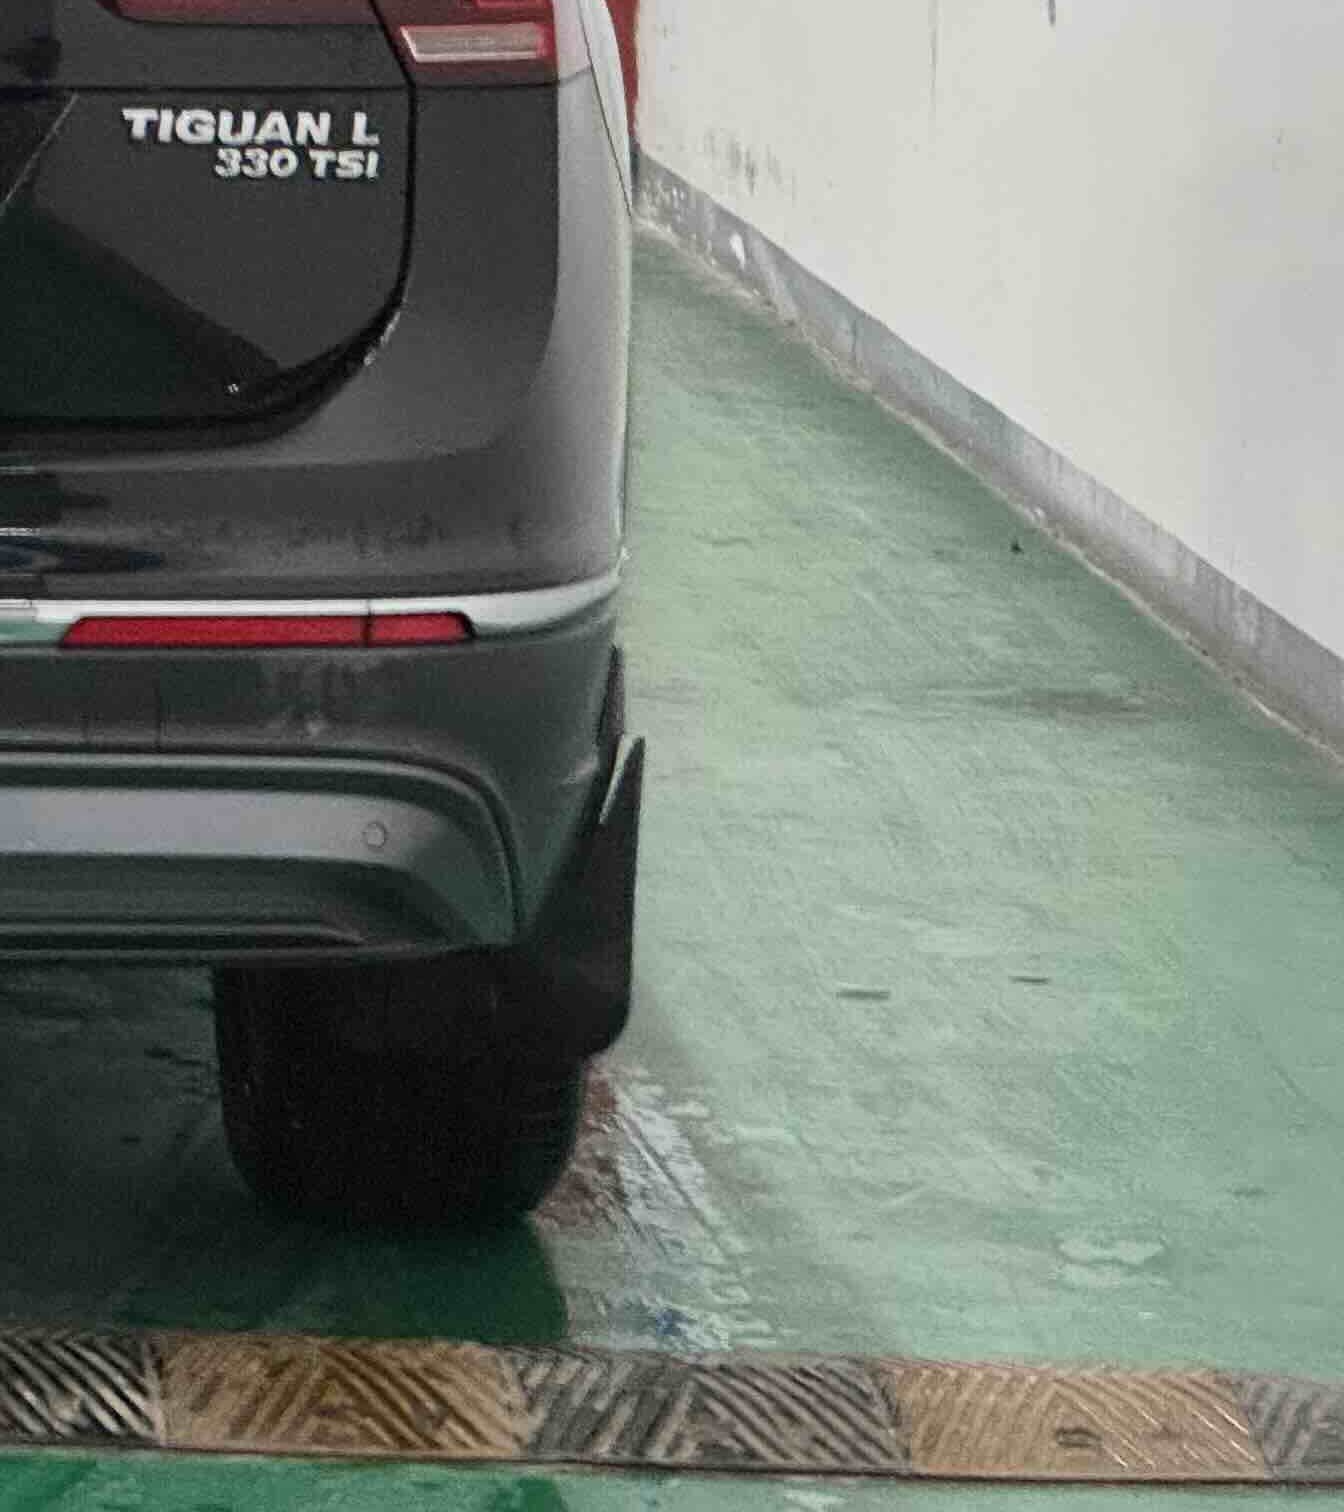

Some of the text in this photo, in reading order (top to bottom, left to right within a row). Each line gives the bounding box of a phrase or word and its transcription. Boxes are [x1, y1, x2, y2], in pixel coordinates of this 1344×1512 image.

[122, 107, 380, 146] TIGUAN L
[214, 148, 380, 179] 330 TSI
